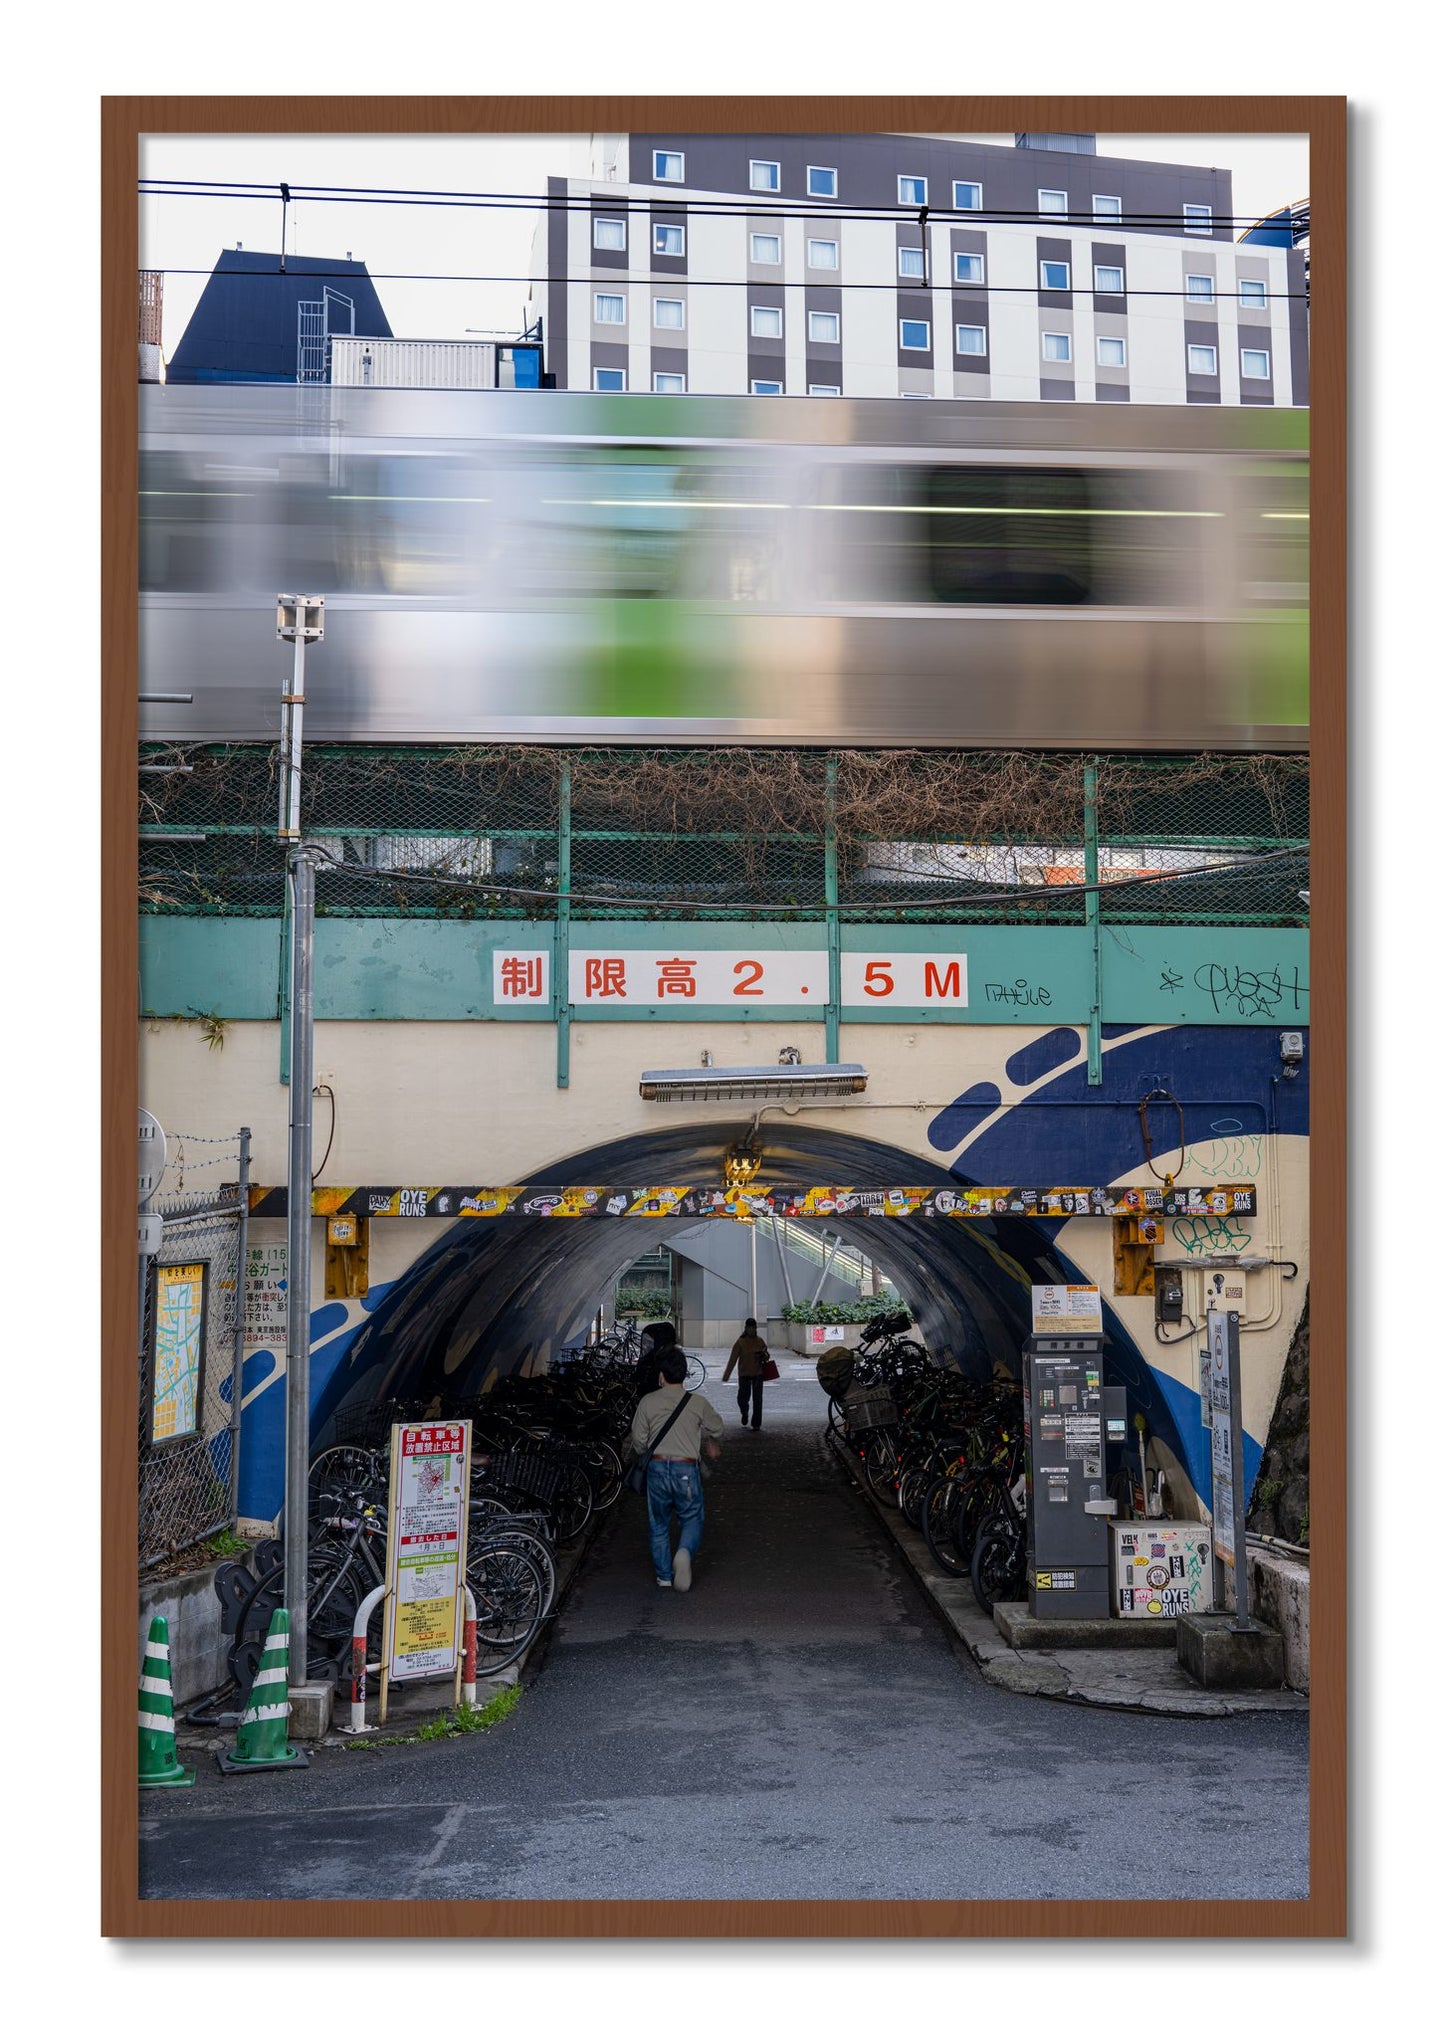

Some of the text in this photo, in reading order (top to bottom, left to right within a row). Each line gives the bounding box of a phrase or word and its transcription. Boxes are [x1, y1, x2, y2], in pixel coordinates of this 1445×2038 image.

[400, 1189, 427, 1203] OYE
[1233, 1192, 1251, 1201] OYE
[399, 1203, 426, 1217] RUNS
[1234, 1200, 1251, 1210] RUNS
[405, 1440, 460, 1454] 放置禁止区域
[1162, 1588, 1189, 1602] OYE
[1163, 1602, 1189, 1616] RUNS
